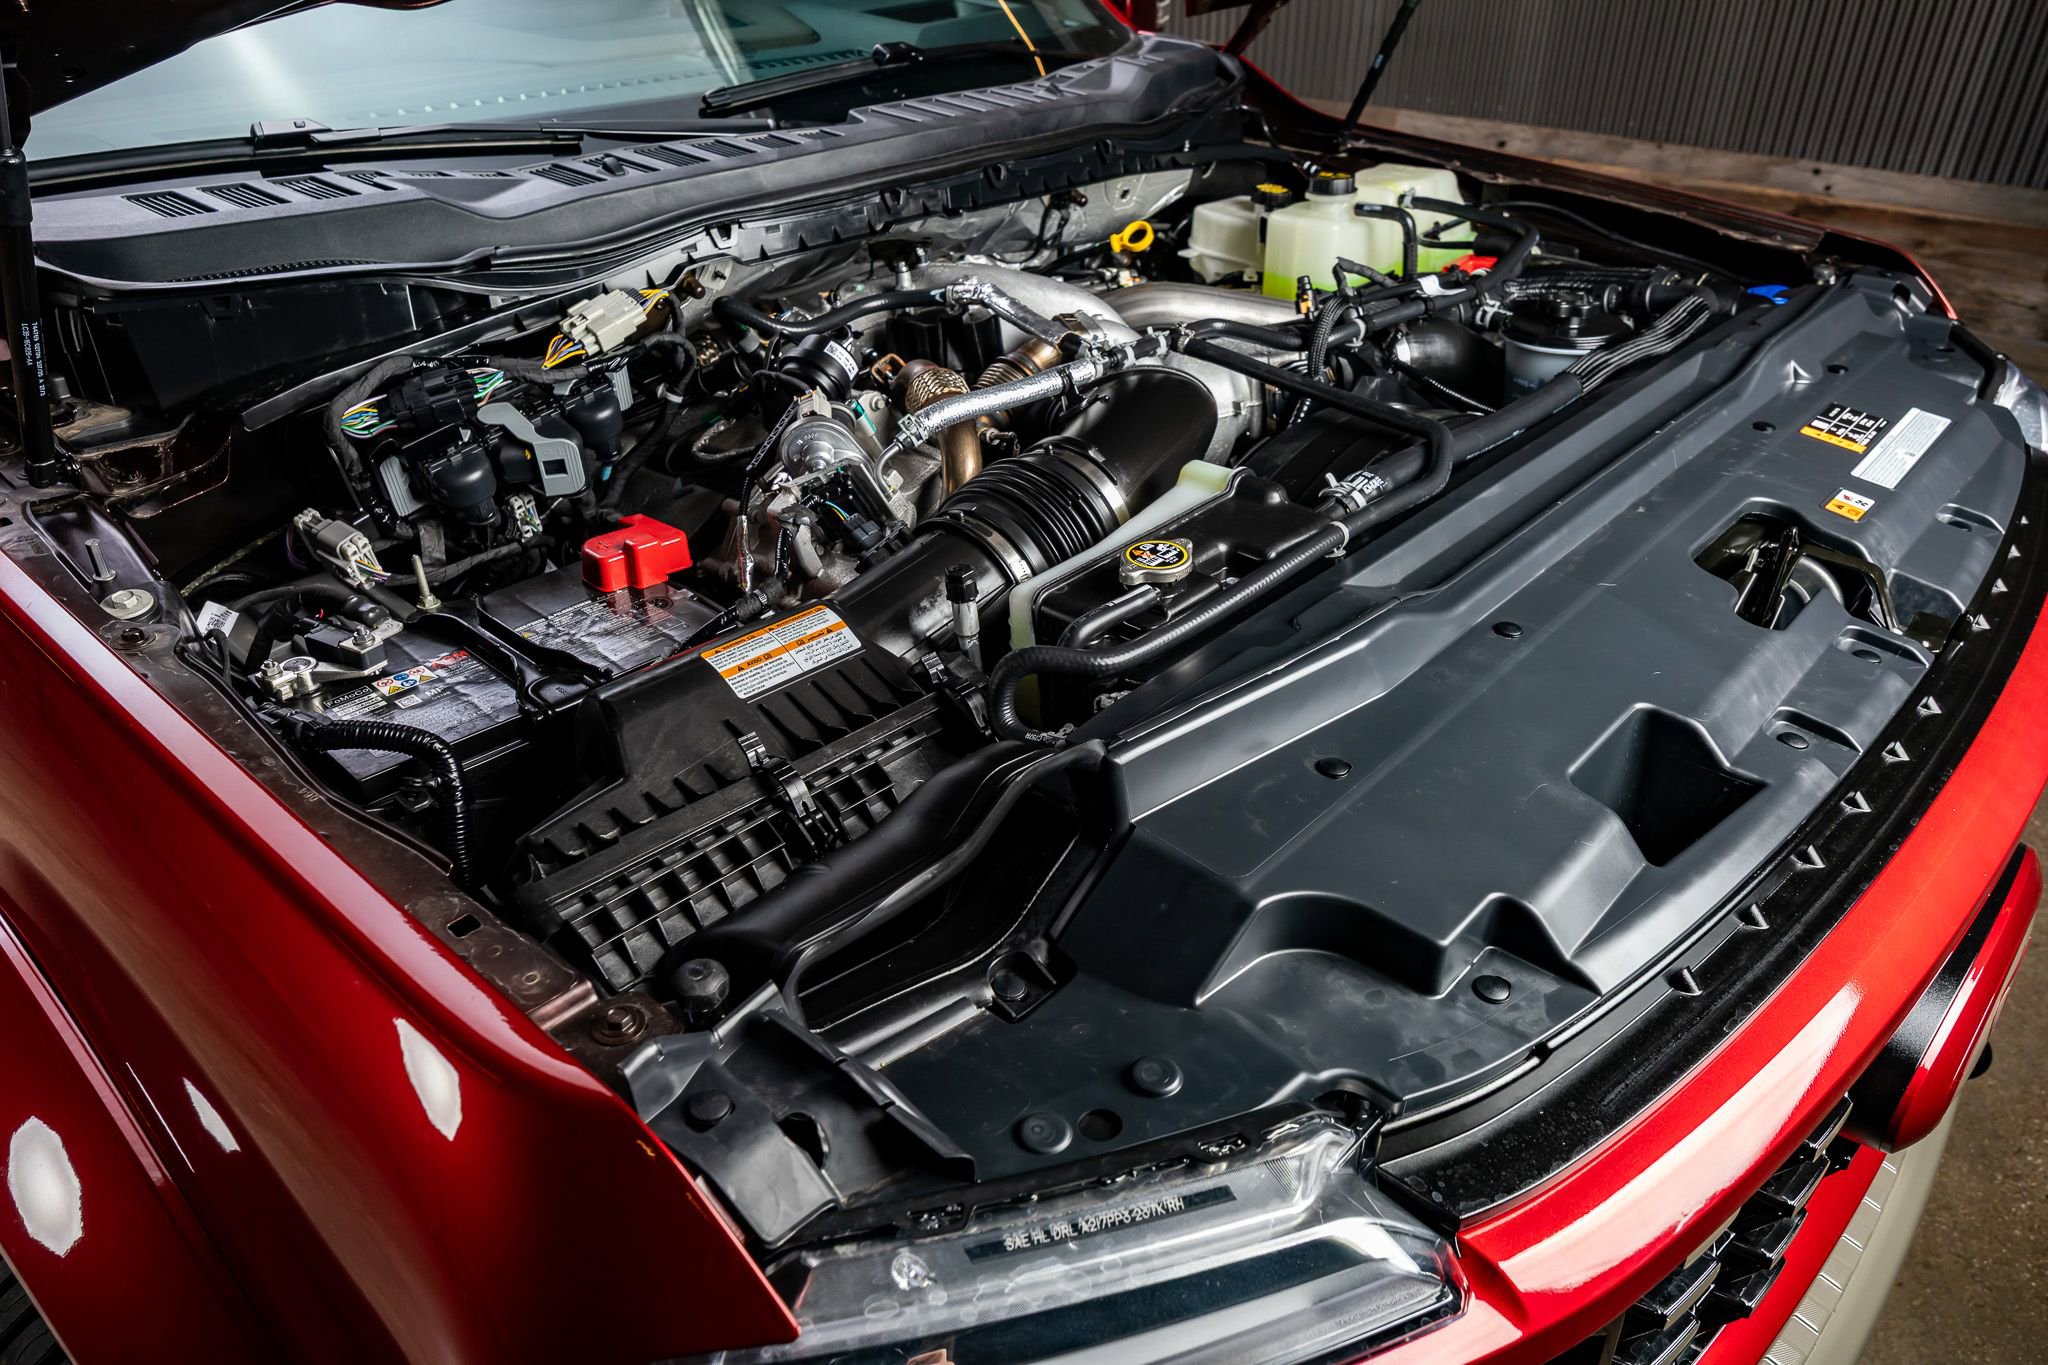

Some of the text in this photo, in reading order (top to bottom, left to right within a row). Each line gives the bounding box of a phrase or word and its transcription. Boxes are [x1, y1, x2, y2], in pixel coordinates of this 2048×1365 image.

[746, 657, 762, 666] AVISO
[326, 687, 370, 706] FoMoCo
[1005, 1231, 1031, 1251] SAE
[1053, 1223, 1078, 1241] DRL
[1168, 1197, 1185, 1213] RH
